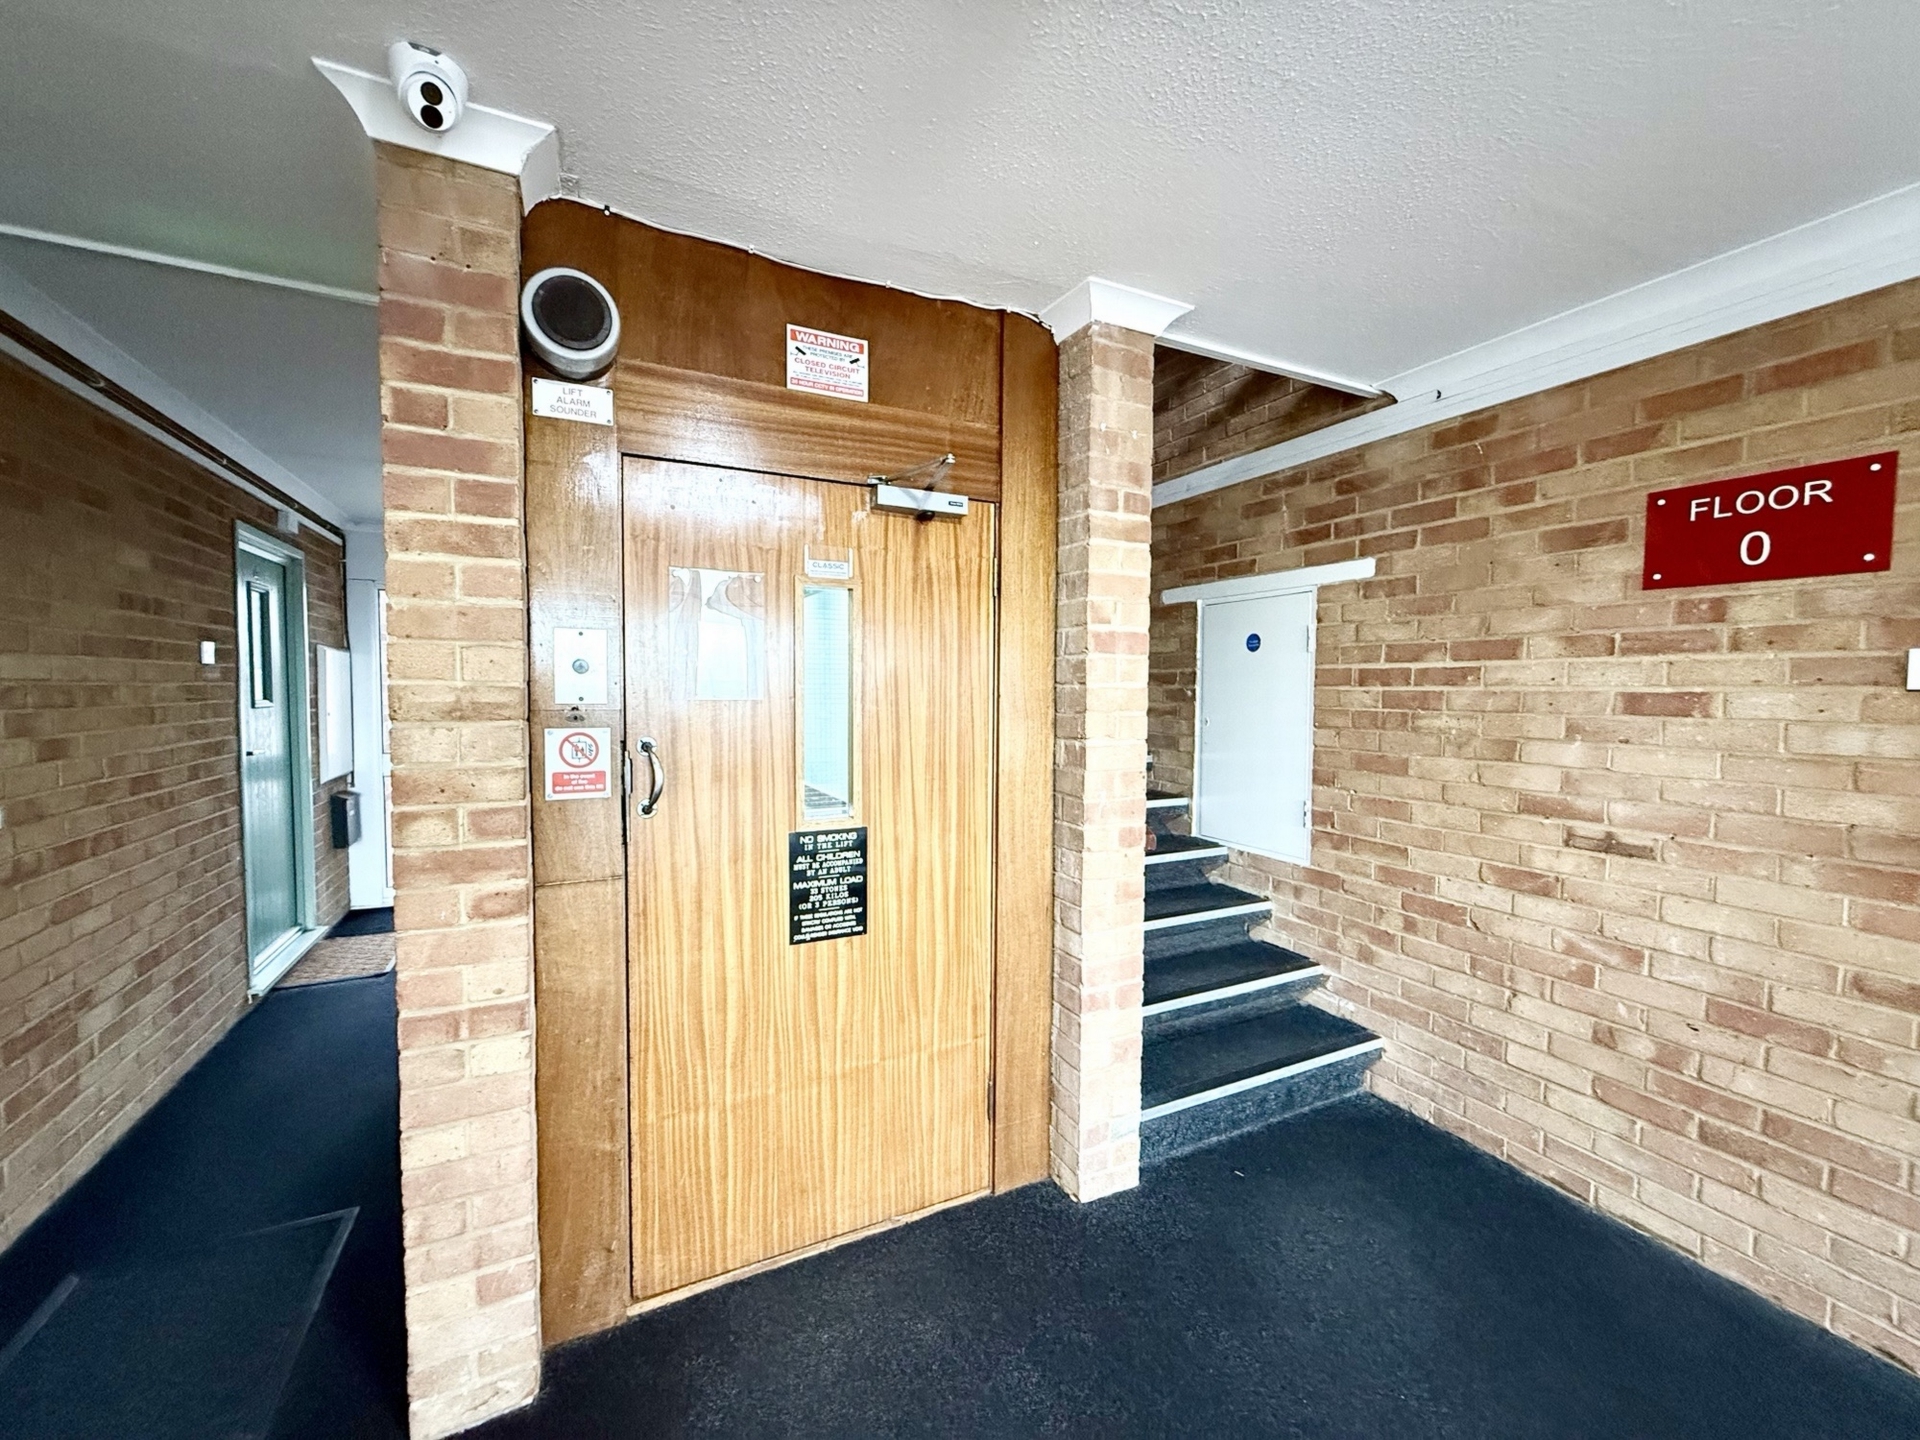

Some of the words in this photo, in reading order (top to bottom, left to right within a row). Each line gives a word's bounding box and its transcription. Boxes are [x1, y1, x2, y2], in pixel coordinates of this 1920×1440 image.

[795, 331, 859, 353] WARNING
[810, 351, 838, 361] PROTECTED
[794, 357, 826, 368] CLOSED
[829, 363, 860, 374] CIRCUIT
[805, 366, 851, 379] TELEVISION
[562, 387, 583, 397] LIFT
[814, 382, 829, 390] CCTV
[556, 396, 591, 408] ALARM
[549, 404, 597, 418] SOUNDER
[1690, 479, 1833, 522] FLOOR
[1739, 531, 1771, 566] 0
[812, 561, 845, 570] CLASSIC
[799, 836, 814, 844] NO
[817, 832, 857, 842] SMOKING
[817, 841, 833, 849] THE
[836, 840, 853, 848] LIFT
[796, 855, 813, 863] ALL
[816, 850, 861, 862] CHILDREN
[793, 863, 810, 871] MUST
[822, 858, 863, 868] ACCOMPANIED
[830, 866, 852, 874] ADULT
[793, 878, 837, 890] MAXIMUM
[840, 875, 864, 884] LOAD
[820, 885, 848, 894] STONES
[826, 891, 849, 900] KILOS
[798, 902, 813, 910] (OR
